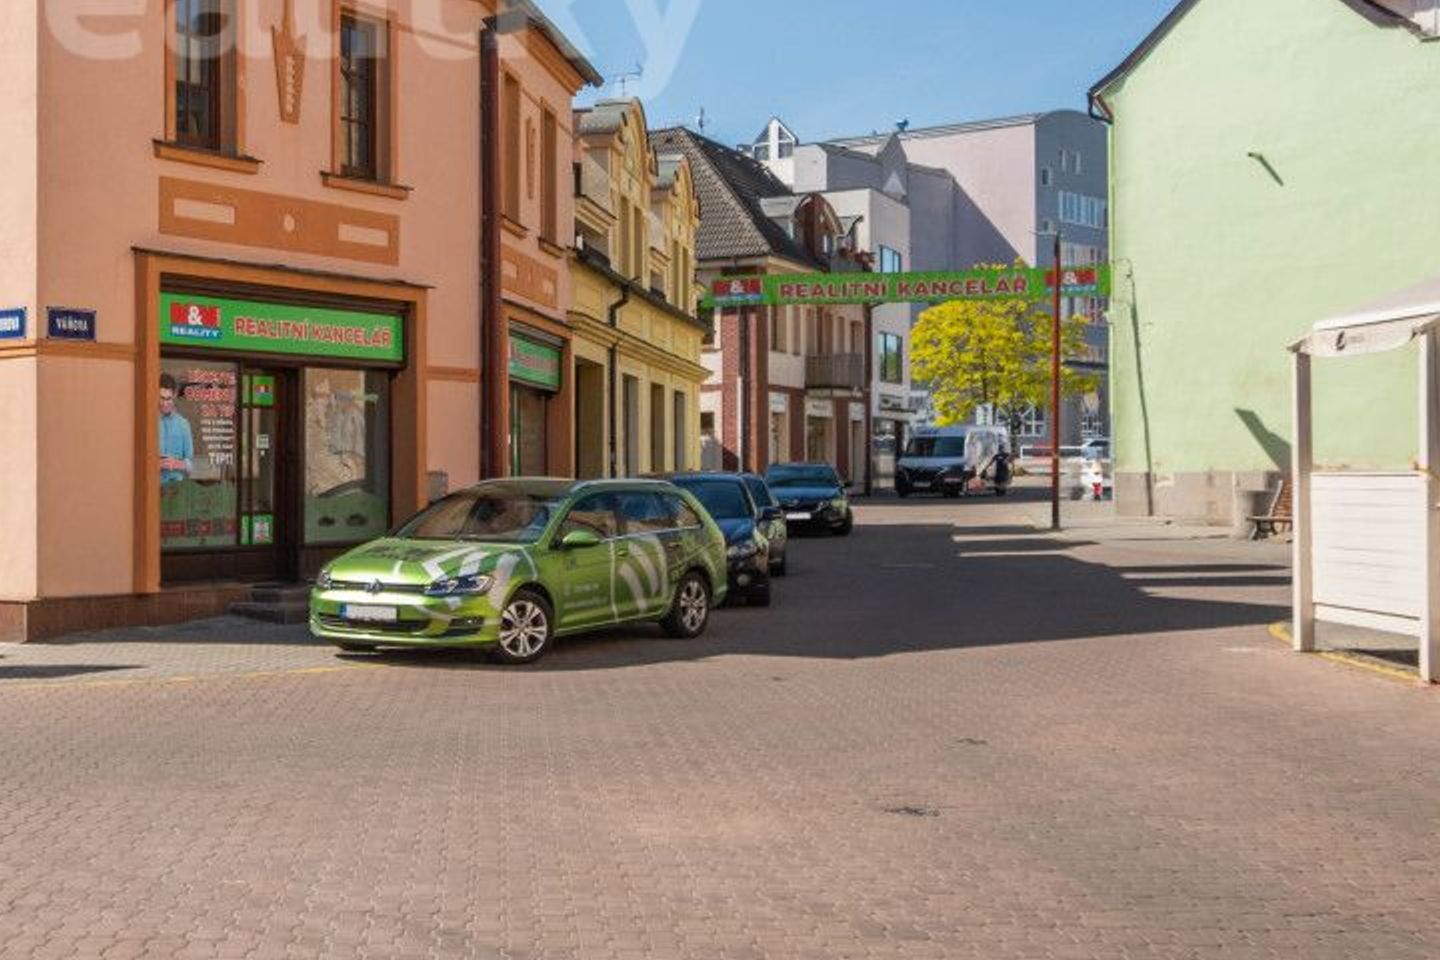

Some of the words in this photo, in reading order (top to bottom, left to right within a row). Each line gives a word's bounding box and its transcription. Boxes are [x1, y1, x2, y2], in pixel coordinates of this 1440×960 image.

[171, 326, 220, 338] REALITY
[233, 314, 309, 341] REALITNÍ
[311, 322, 393, 348] KANCELÁŘ
